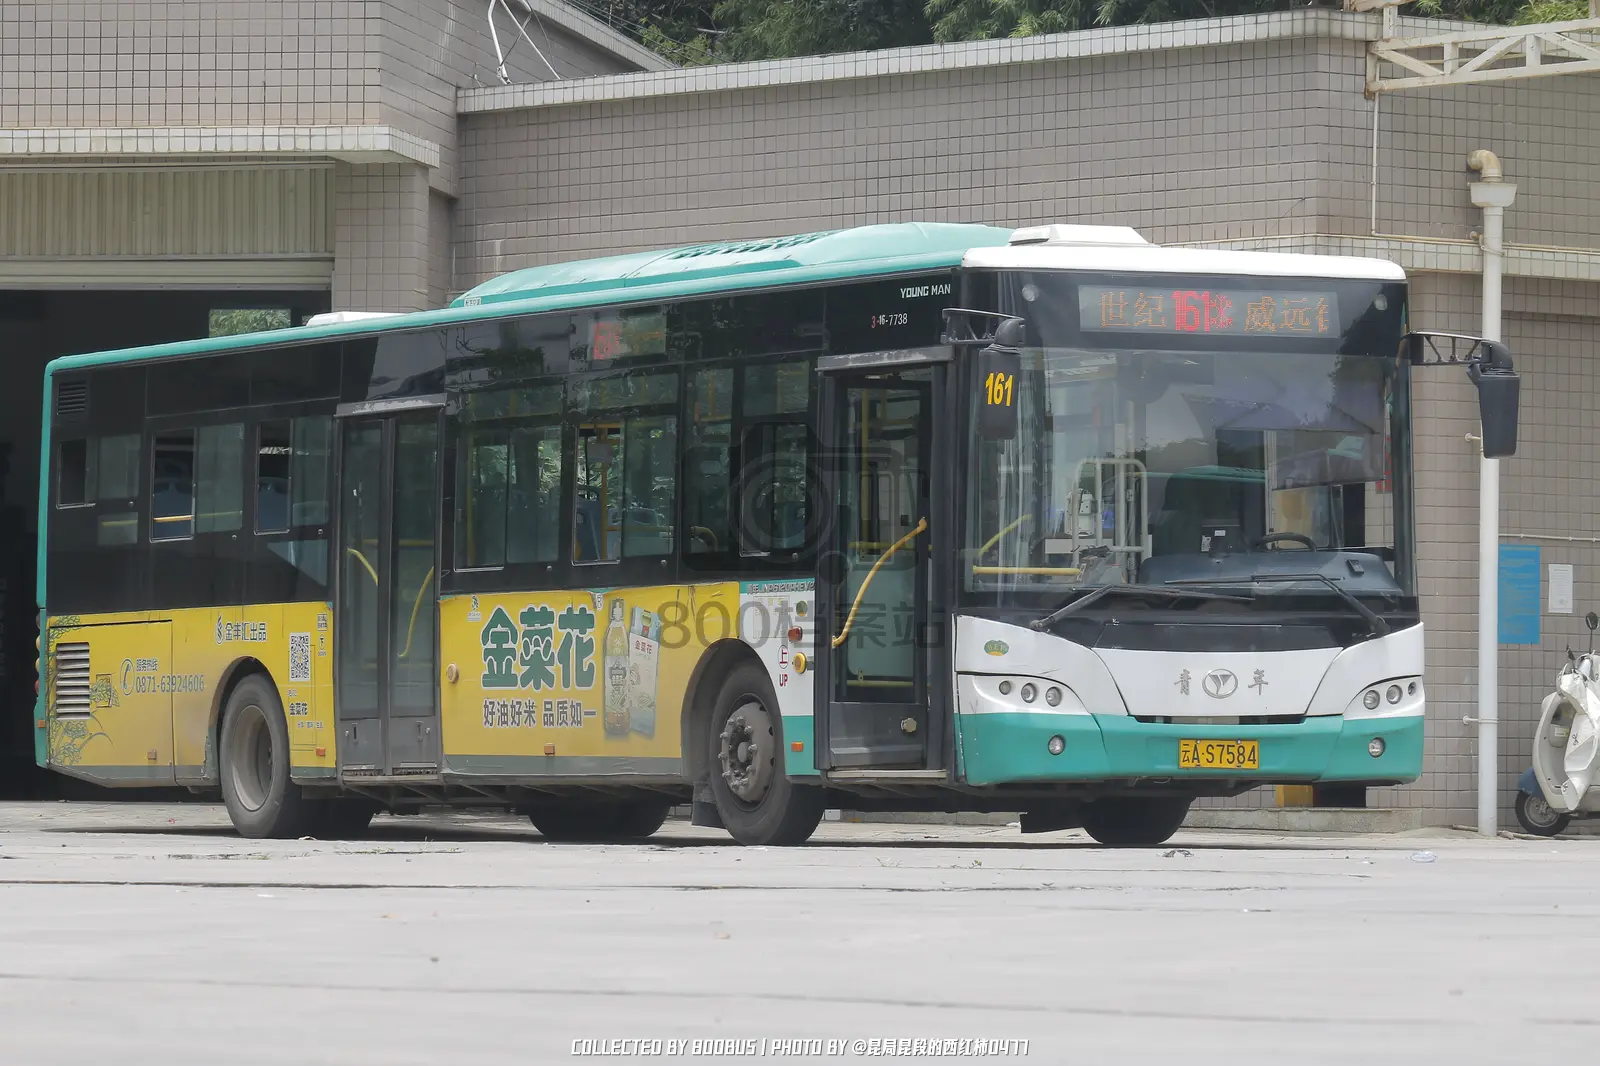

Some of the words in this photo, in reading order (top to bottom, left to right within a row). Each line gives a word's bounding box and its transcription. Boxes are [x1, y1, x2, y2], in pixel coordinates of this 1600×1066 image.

[900, 285, 929, 299] YOUNG
[931, 283, 951, 295] MAN
[1098, 291, 1167, 328] 世纪
[871, 313, 908, 329] 3-16-7738
[985, 372, 1014, 407] 161
[224, 621, 268, 642] 金丰汇出品
[481, 604, 596, 691] 金菜花
[779, 648, 788, 665] 上
[135, 673, 205, 694] 0871-63924606
[779, 673, 788, 687] UP
[1173, 668, 1192, 696] 青
[483, 700, 537, 728] 好油好米
[543, 701, 597, 728] 品质如一
[1181, 743, 1257, 765] 云A·S7584
